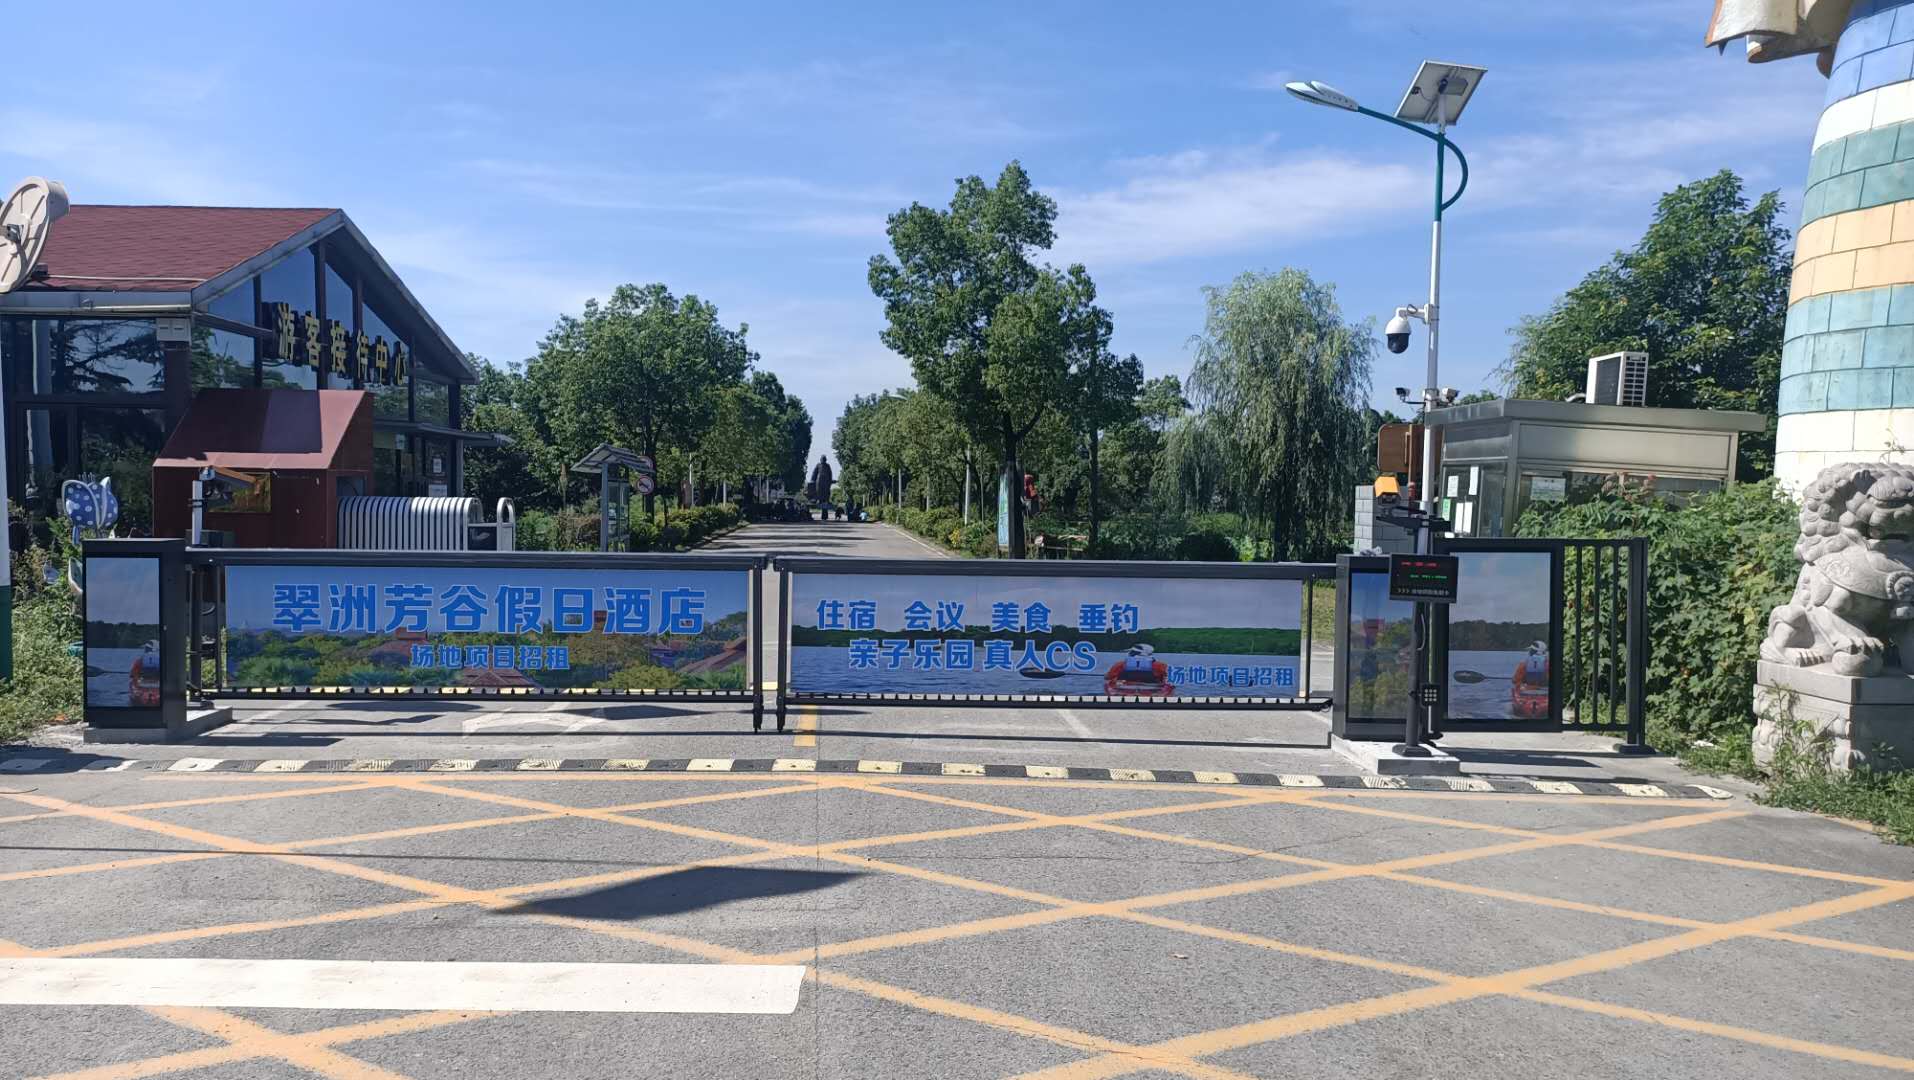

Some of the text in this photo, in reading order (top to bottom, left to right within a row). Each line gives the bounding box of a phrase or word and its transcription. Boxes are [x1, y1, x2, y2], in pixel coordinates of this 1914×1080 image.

[272, 582, 707, 636] 翠洲芳谷假日酒店
[816, 599, 1140, 634] 住宿 会议 美食 垂钓
[411, 643, 571, 671] 场地项目招租
[849, 637, 1097, 673] 亲子乐园 真人CS
[1167, 664, 1295, 688] 场地项目招租
